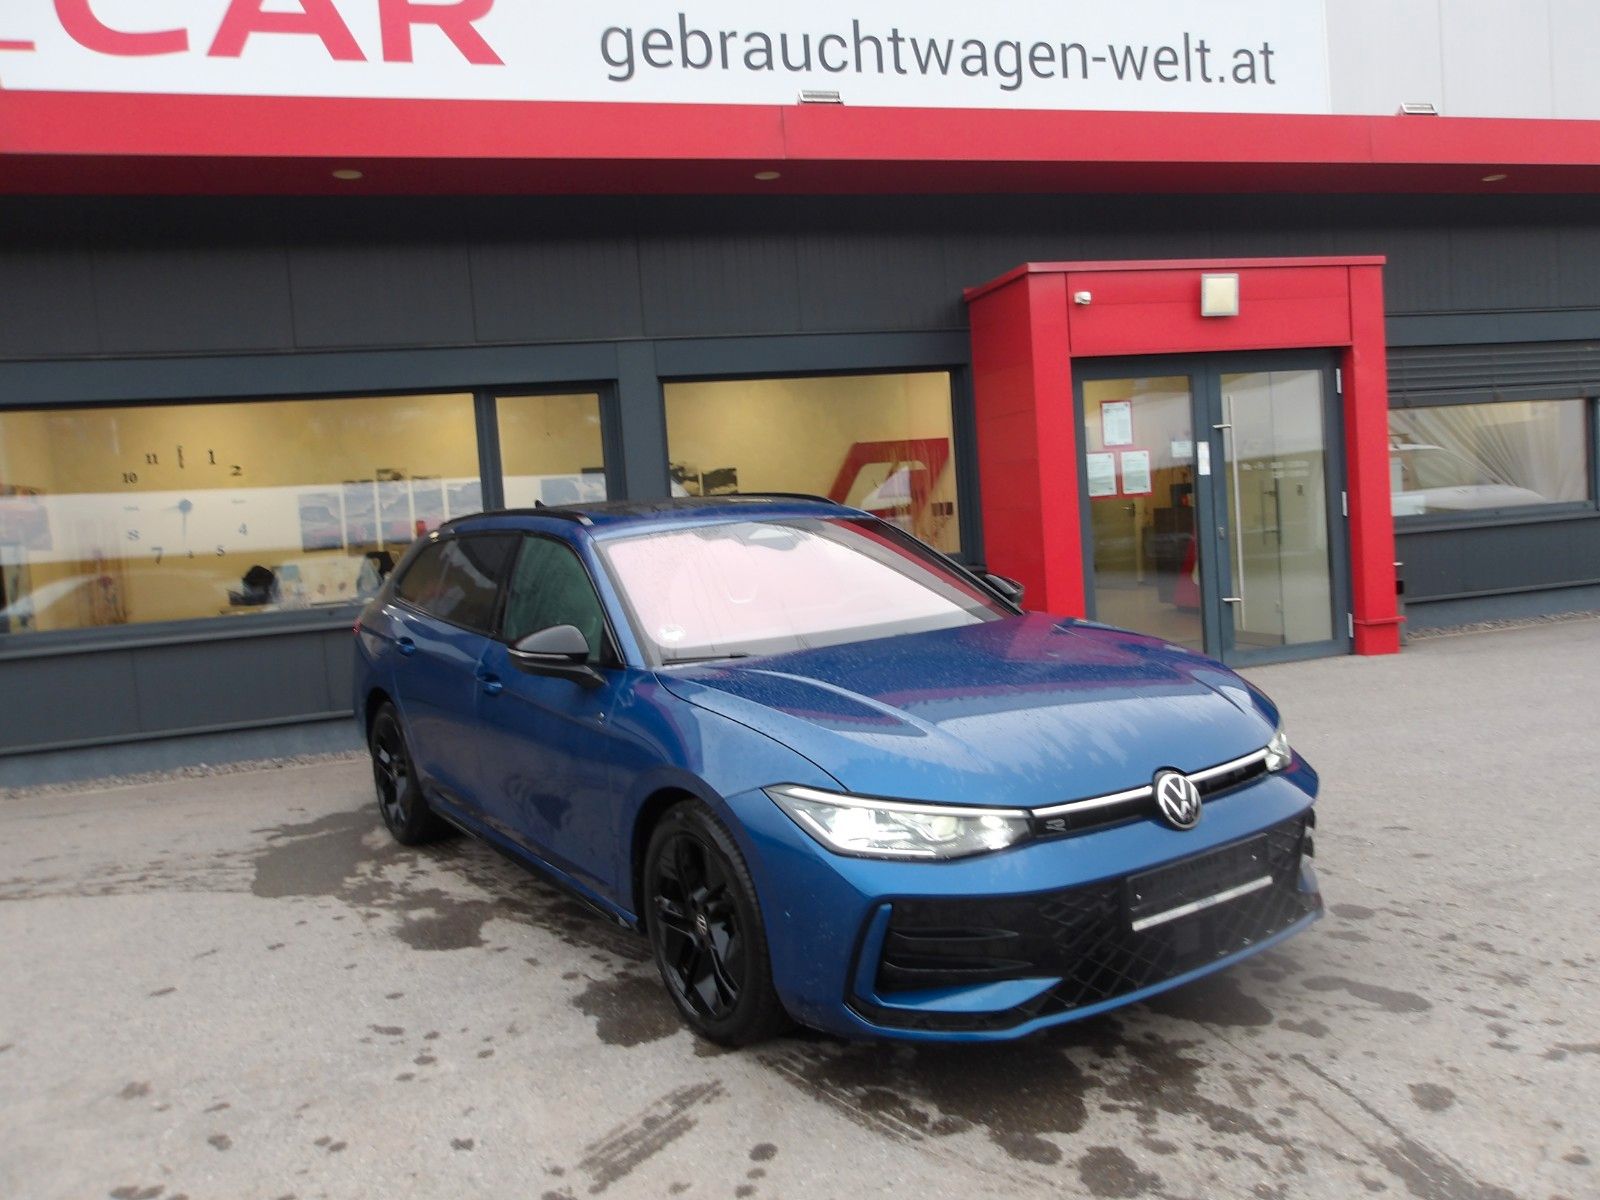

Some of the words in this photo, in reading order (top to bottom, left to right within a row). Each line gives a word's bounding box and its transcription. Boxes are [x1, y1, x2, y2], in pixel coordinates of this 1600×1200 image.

[0, 0, 506, 66] CAR
[600, 12, 1276, 91] gebrauchtwagen-welt.at
[122, 472, 138, 484] 10
